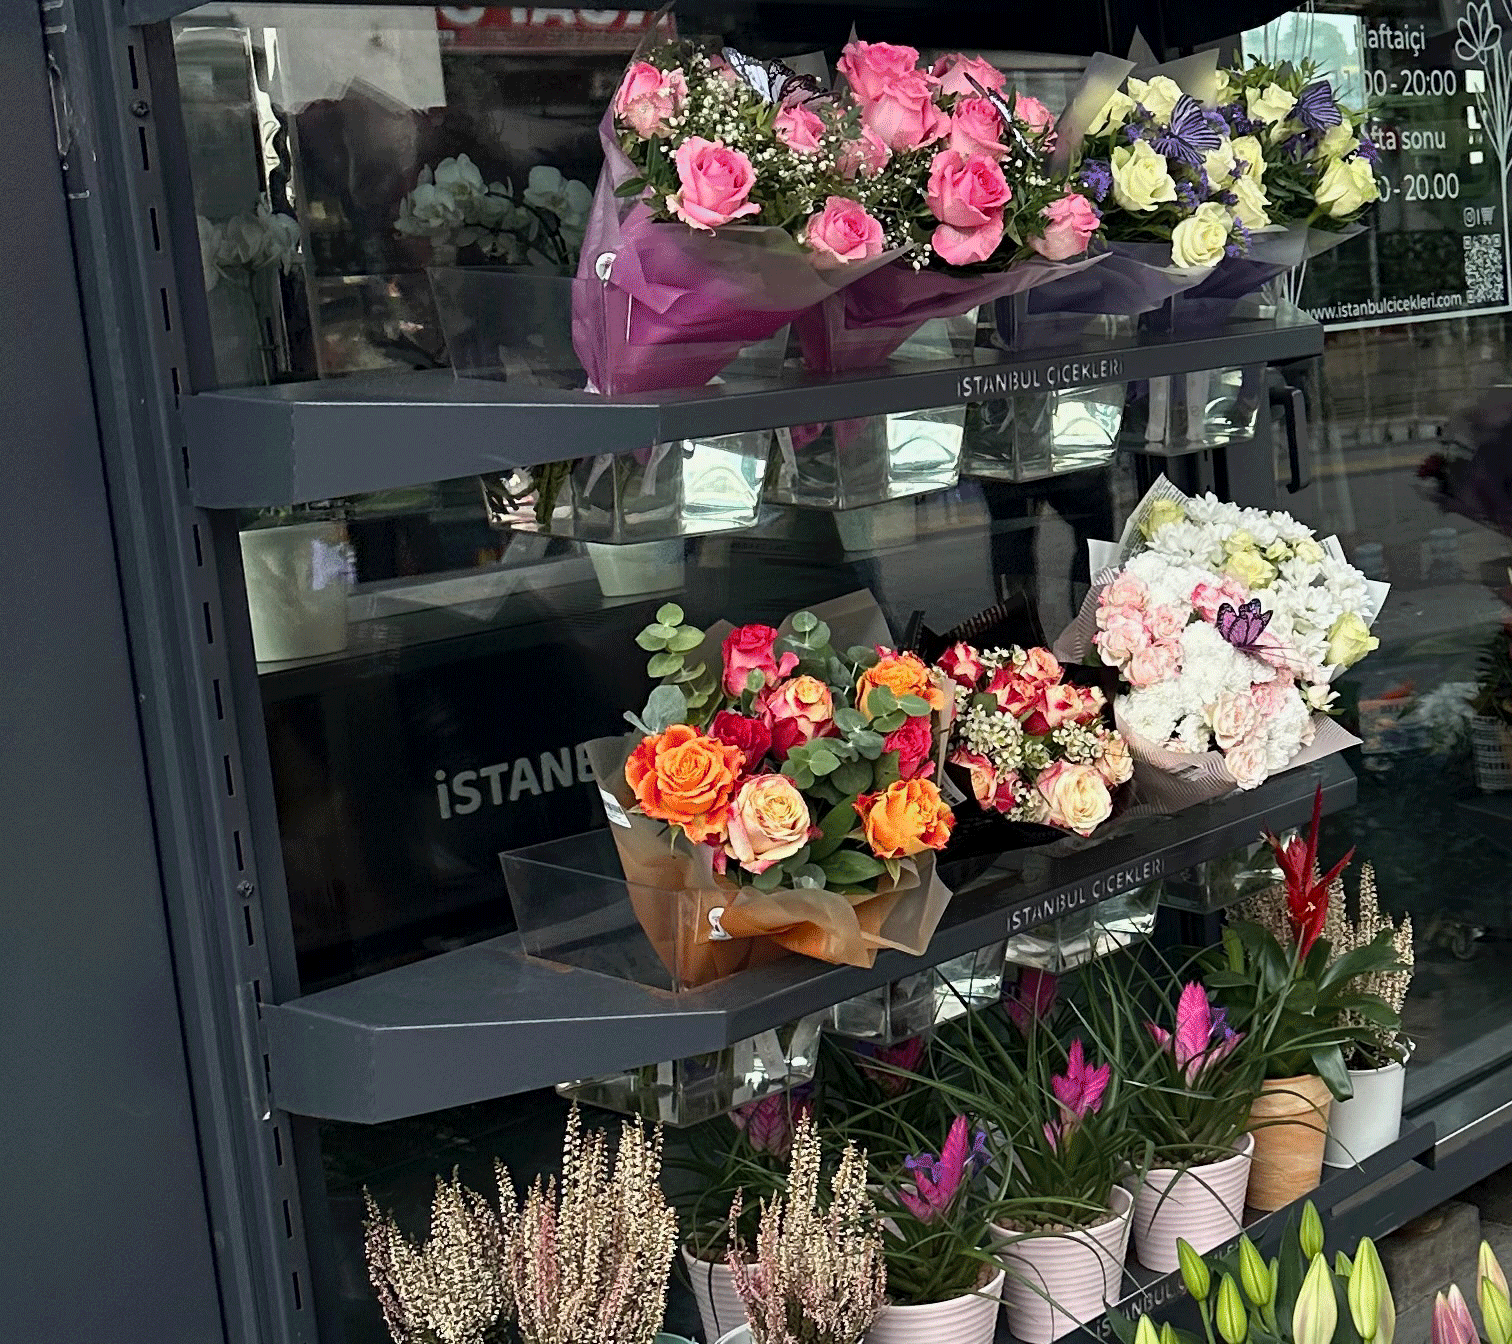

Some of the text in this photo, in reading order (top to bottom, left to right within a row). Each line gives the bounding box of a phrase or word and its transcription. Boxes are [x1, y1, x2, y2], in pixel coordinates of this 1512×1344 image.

[1401, 69, 1457, 97] 20:00
[1401, 130, 1447, 150] sonu
[1404, 173, 1460, 201] 20.00
